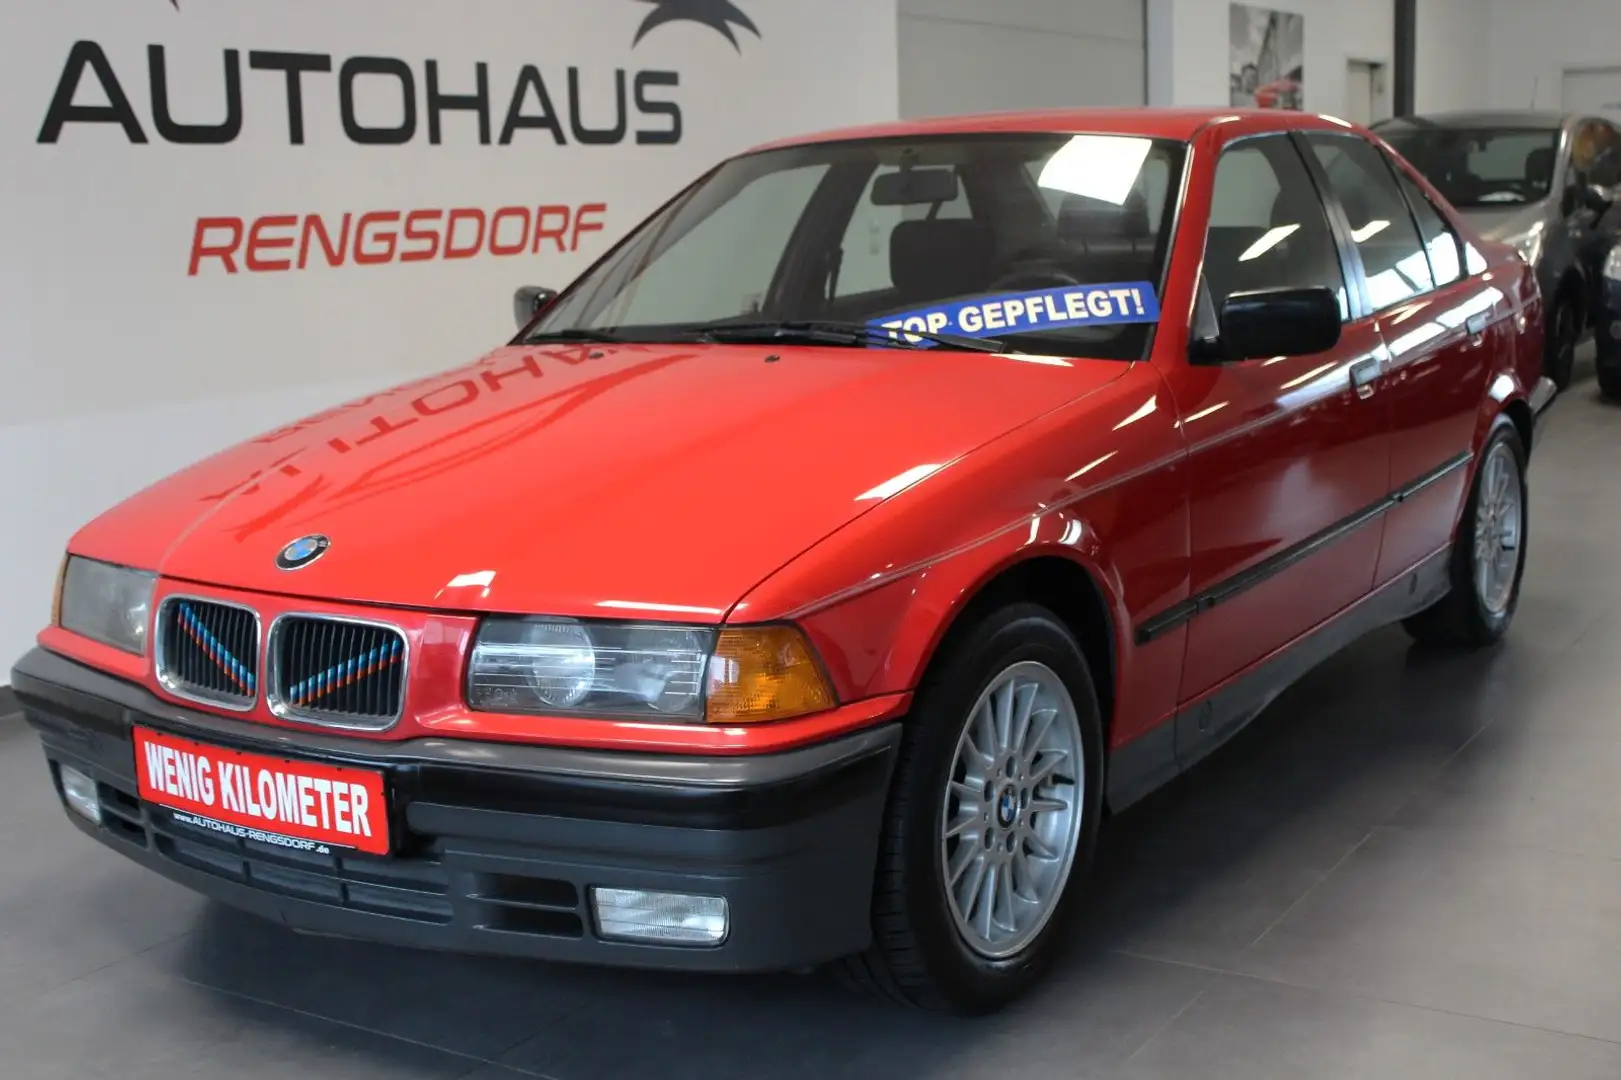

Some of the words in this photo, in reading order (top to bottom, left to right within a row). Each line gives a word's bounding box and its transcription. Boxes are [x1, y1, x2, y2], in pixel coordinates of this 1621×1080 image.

[36, 40, 682, 146] AUTOHAUS
[188, 203, 607, 277] RENGSDORF
[957, 287, 1146, 333] GEPFLEGT!
[143, 740, 215, 806] WENIG
[217, 760, 373, 838] KILOMETER
